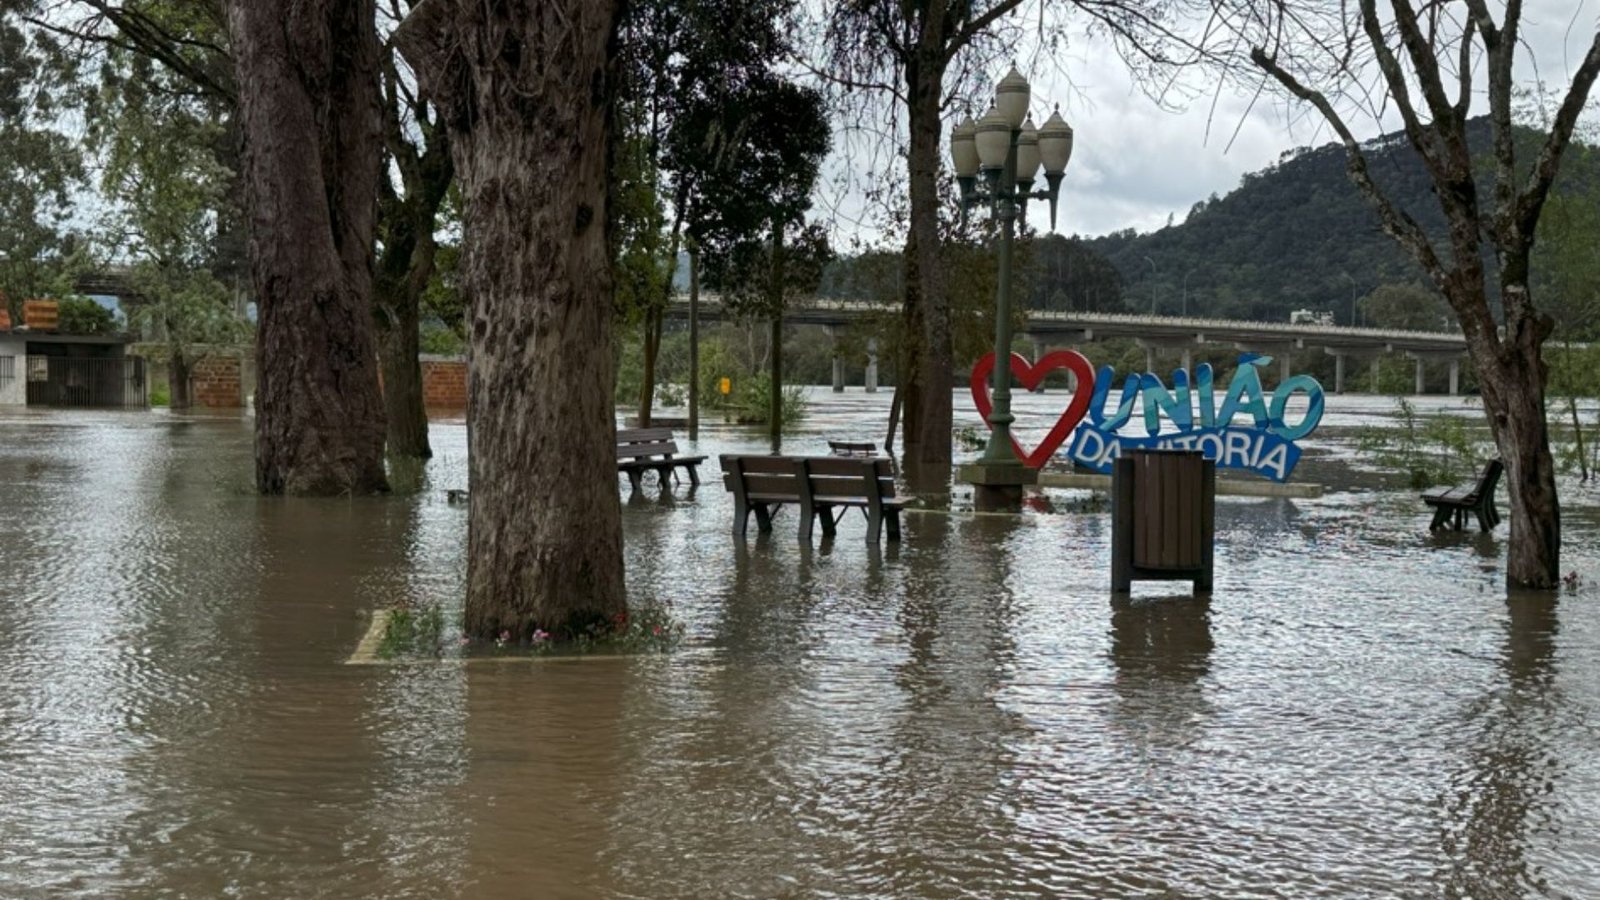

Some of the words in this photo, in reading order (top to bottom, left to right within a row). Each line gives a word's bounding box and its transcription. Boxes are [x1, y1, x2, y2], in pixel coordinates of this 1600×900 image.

[1089, 353, 1325, 441] UNIÃO
[1075, 429, 1121, 468] DA
[1138, 429, 1288, 480] TÓRIA
